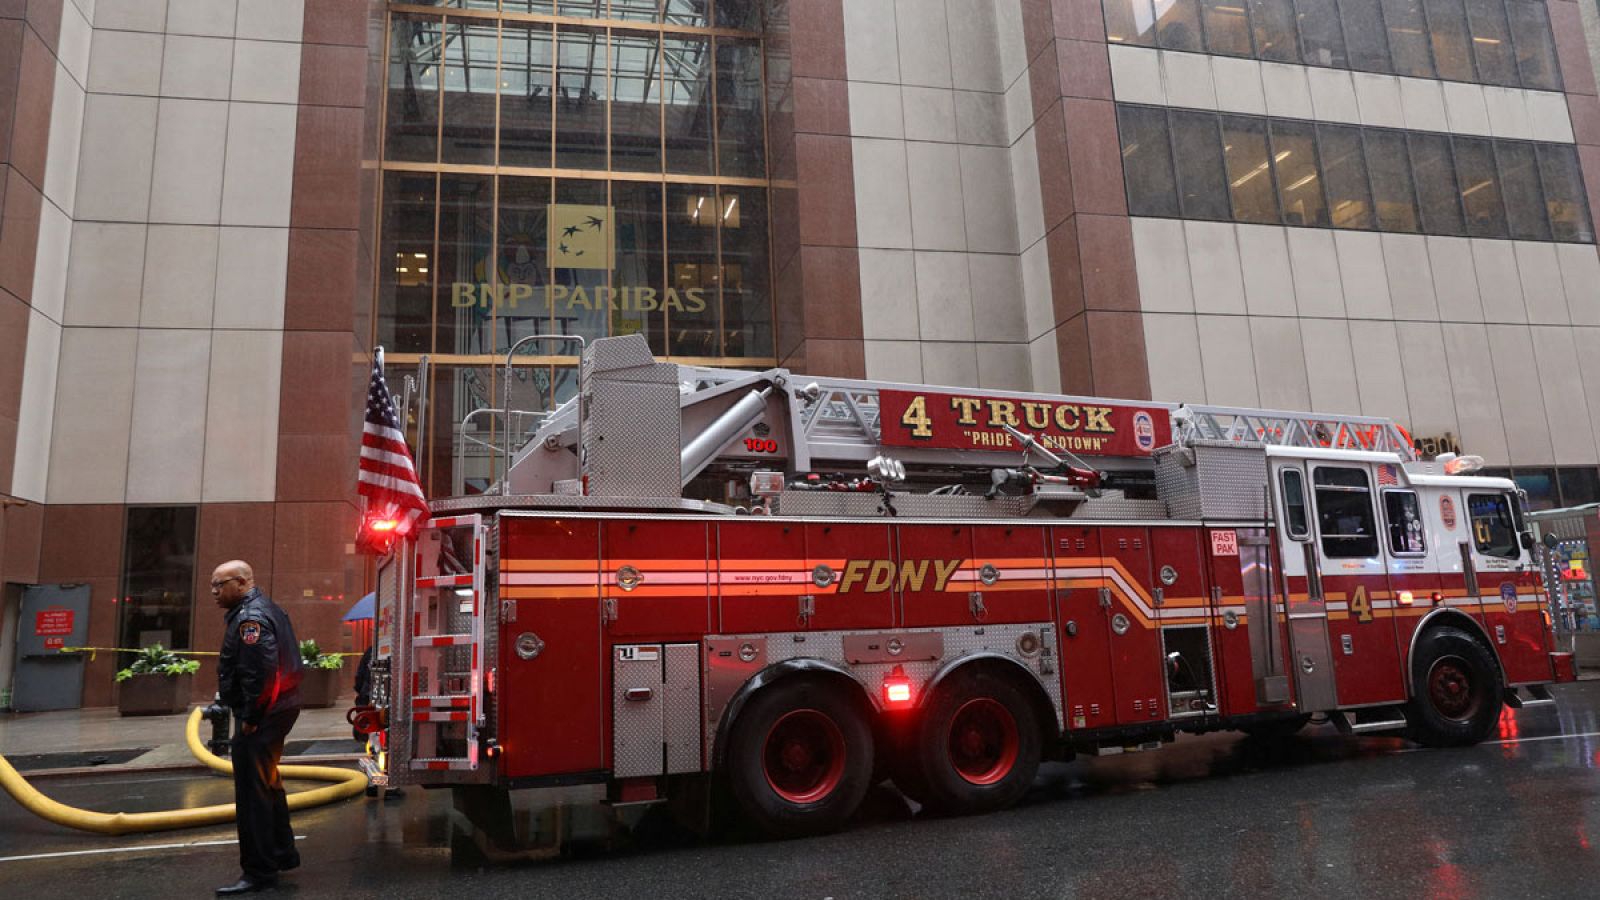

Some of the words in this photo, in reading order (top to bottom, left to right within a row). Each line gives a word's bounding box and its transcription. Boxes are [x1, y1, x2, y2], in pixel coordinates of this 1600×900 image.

[451, 282, 533, 309] BNP
[544, 284, 707, 314] PARIBAS
[901, 395, 933, 437] 4
[951, 396, 1115, 434] TRUCK
[743, 436, 777, 453] 100
[1212, 532, 1235, 542] FAST
[1216, 543, 1236, 554] PAK
[838, 559, 960, 593] FDNY
[1350, 584, 1373, 623] 4
